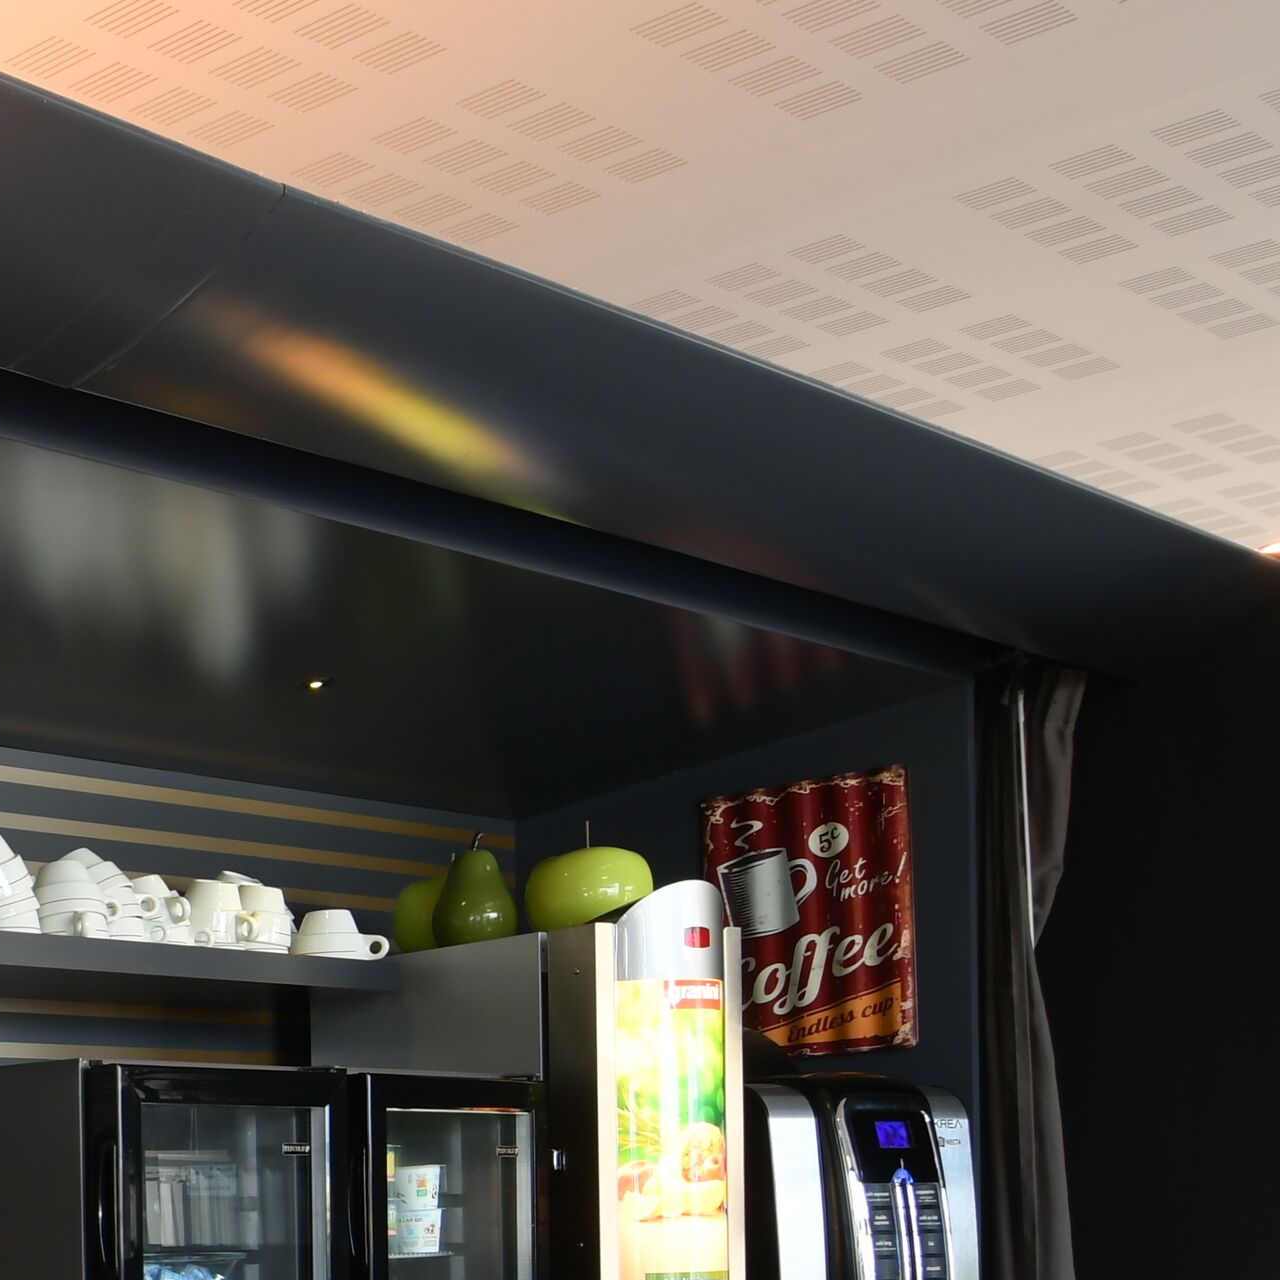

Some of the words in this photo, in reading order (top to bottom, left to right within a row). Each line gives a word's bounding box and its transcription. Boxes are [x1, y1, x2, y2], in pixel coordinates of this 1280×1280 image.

[825, 857, 867, 897] Get
[840, 852, 907, 902] more!
[787, 1008, 855, 1043] Endless
[861, 997, 895, 1020] cup
